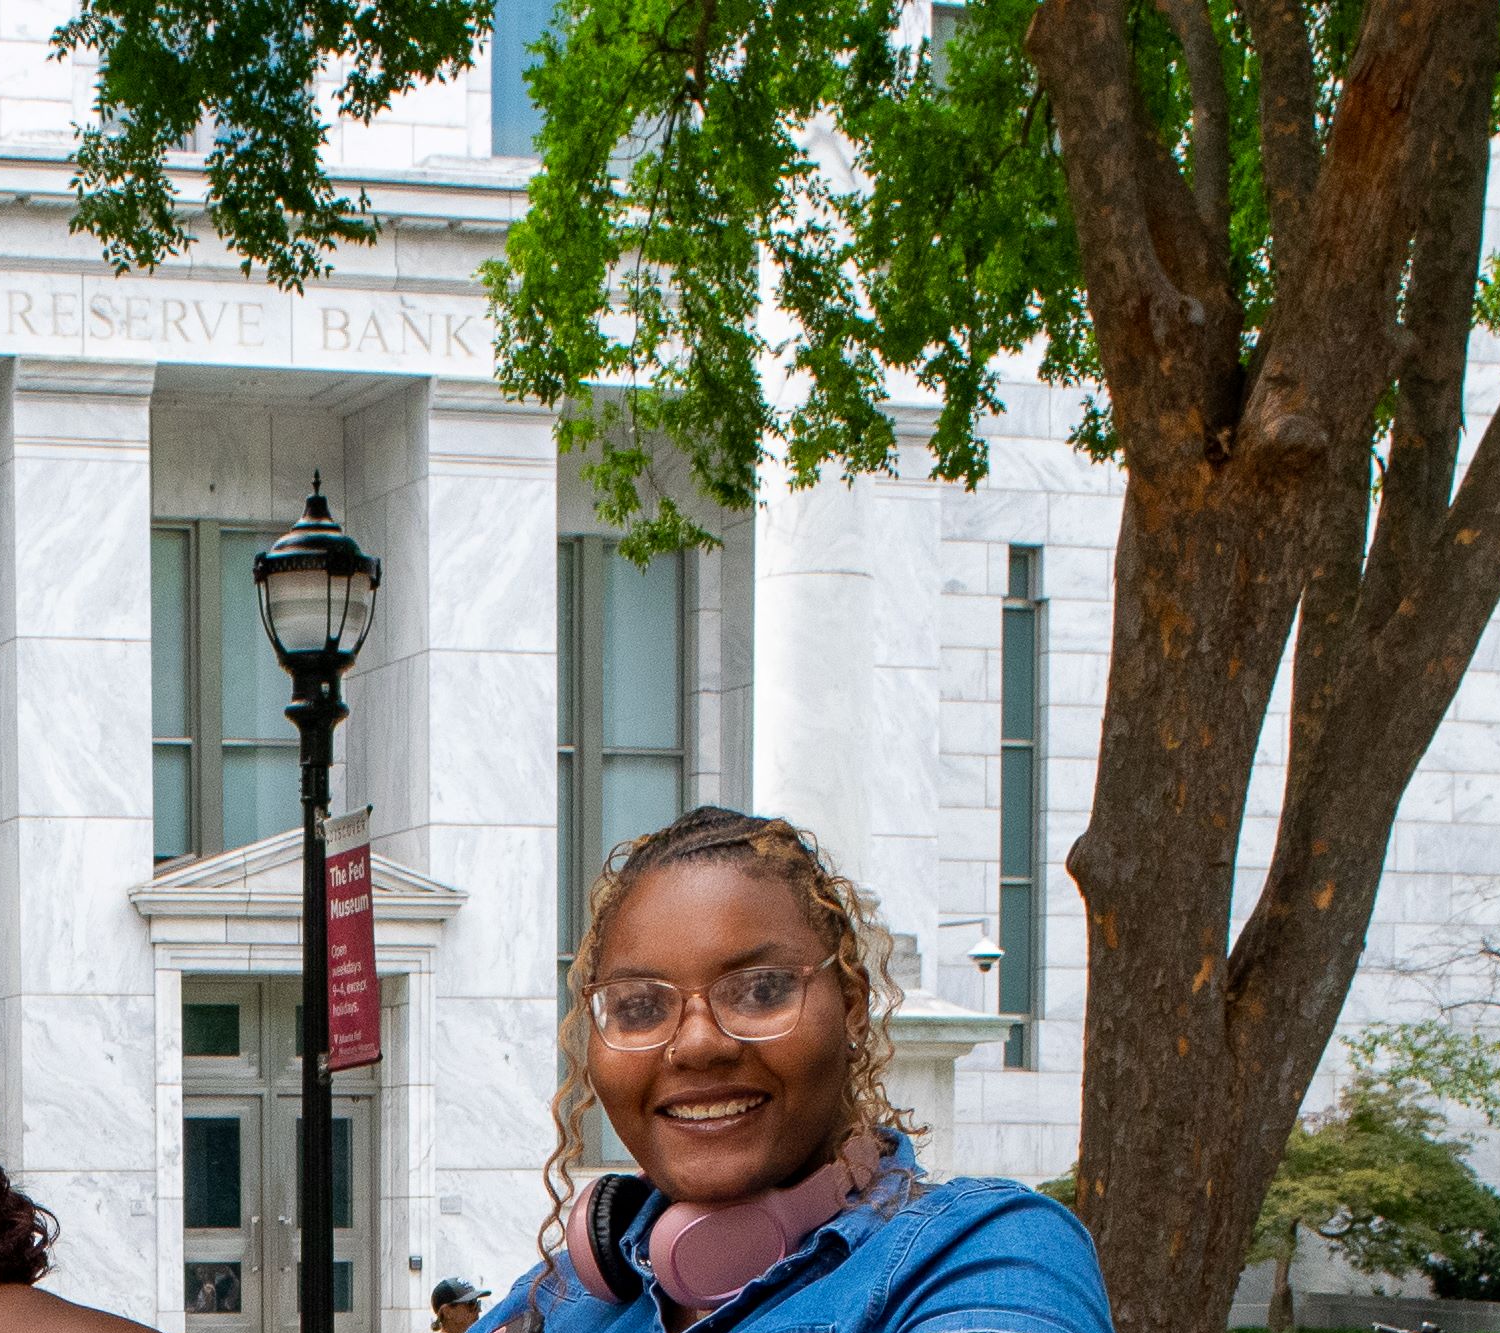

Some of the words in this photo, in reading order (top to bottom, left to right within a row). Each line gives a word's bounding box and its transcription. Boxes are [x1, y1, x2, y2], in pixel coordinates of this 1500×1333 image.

[7, 289, 267, 347] RESERVE
[321, 306, 483, 359] BANK
[329, 864, 347, 888] The
[348, 857, 365, 882] Fed
[330, 893, 369, 920] Museum
